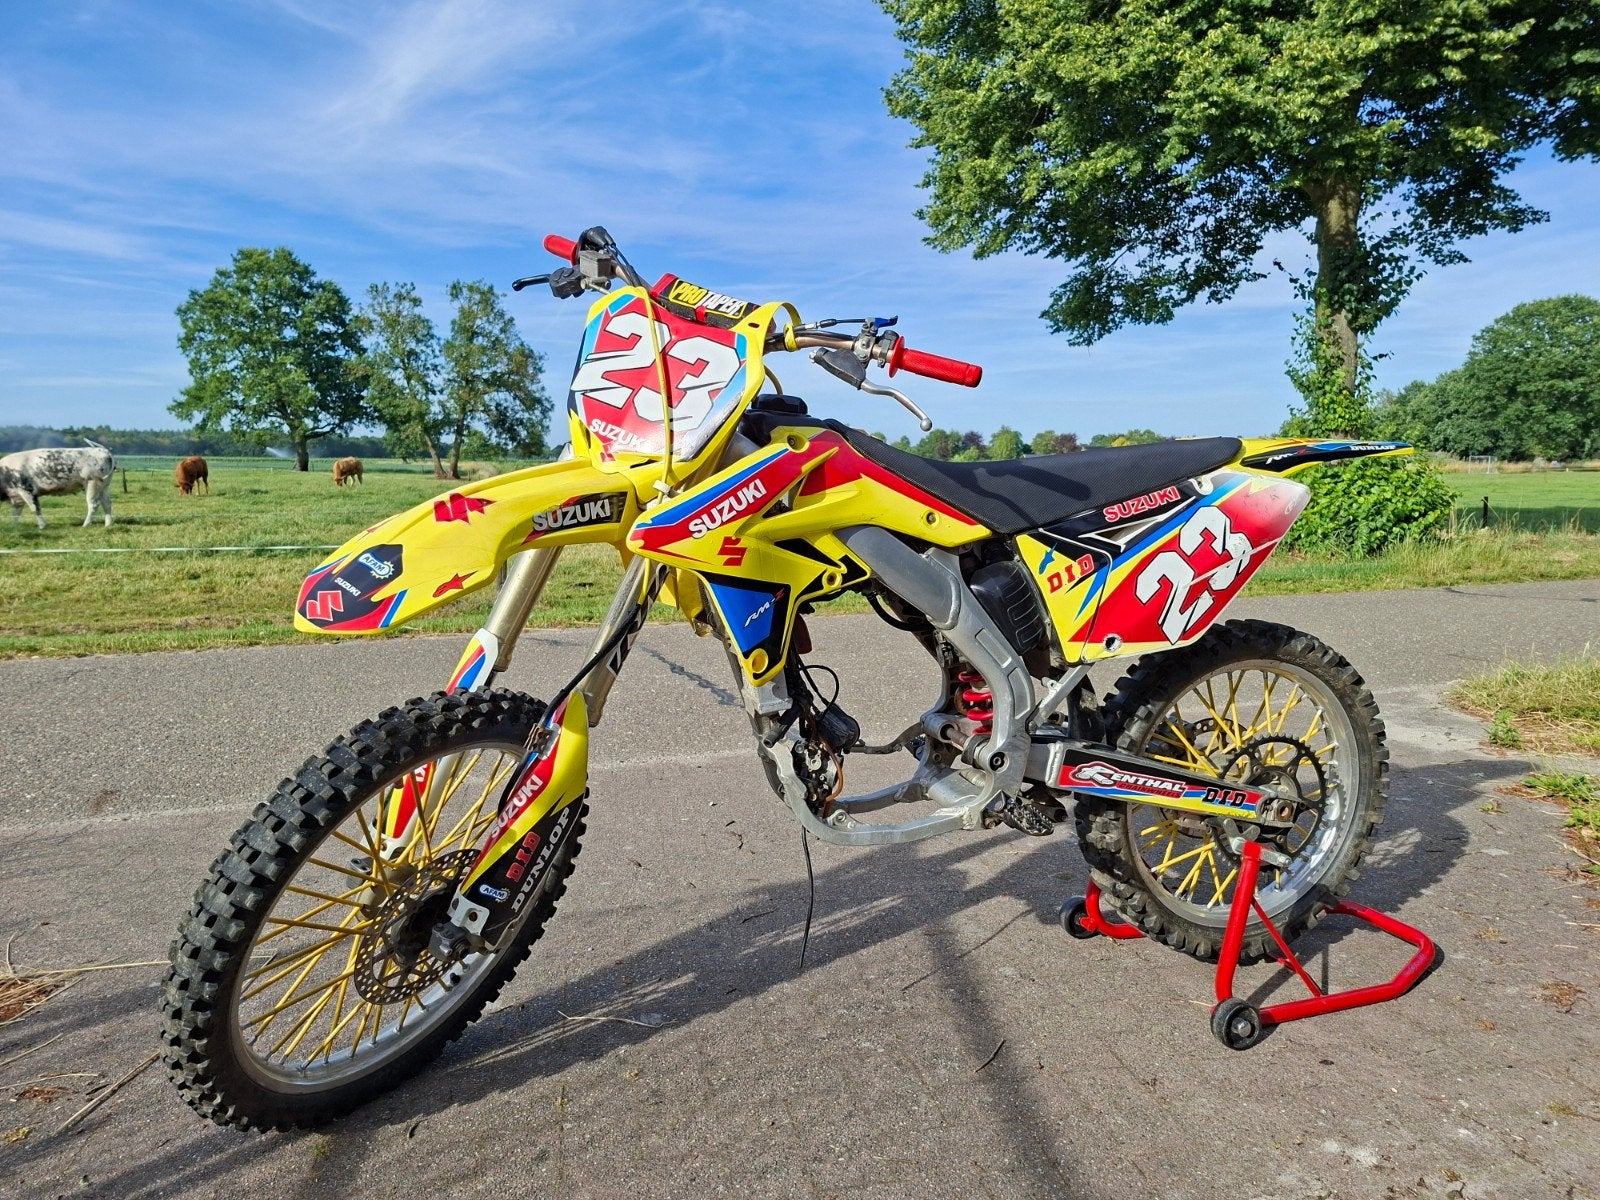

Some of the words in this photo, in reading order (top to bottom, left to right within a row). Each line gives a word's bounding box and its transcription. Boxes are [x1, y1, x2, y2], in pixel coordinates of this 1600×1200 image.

[571, 311, 742, 432] 23
[589, 418, 642, 448] SUZUK
[532, 499, 611, 531] SUZUKI
[689, 479, 767, 539] SUZUKI
[1103, 486, 1181, 522] SUZUKI
[363, 556, 384, 572] AFAM
[1135, 506, 1252, 644] 23
[334, 577, 361, 597] SUZUKI
[510, 806, 570, 913] DUNLOP
[482, 887, 505, 899] AFAM
